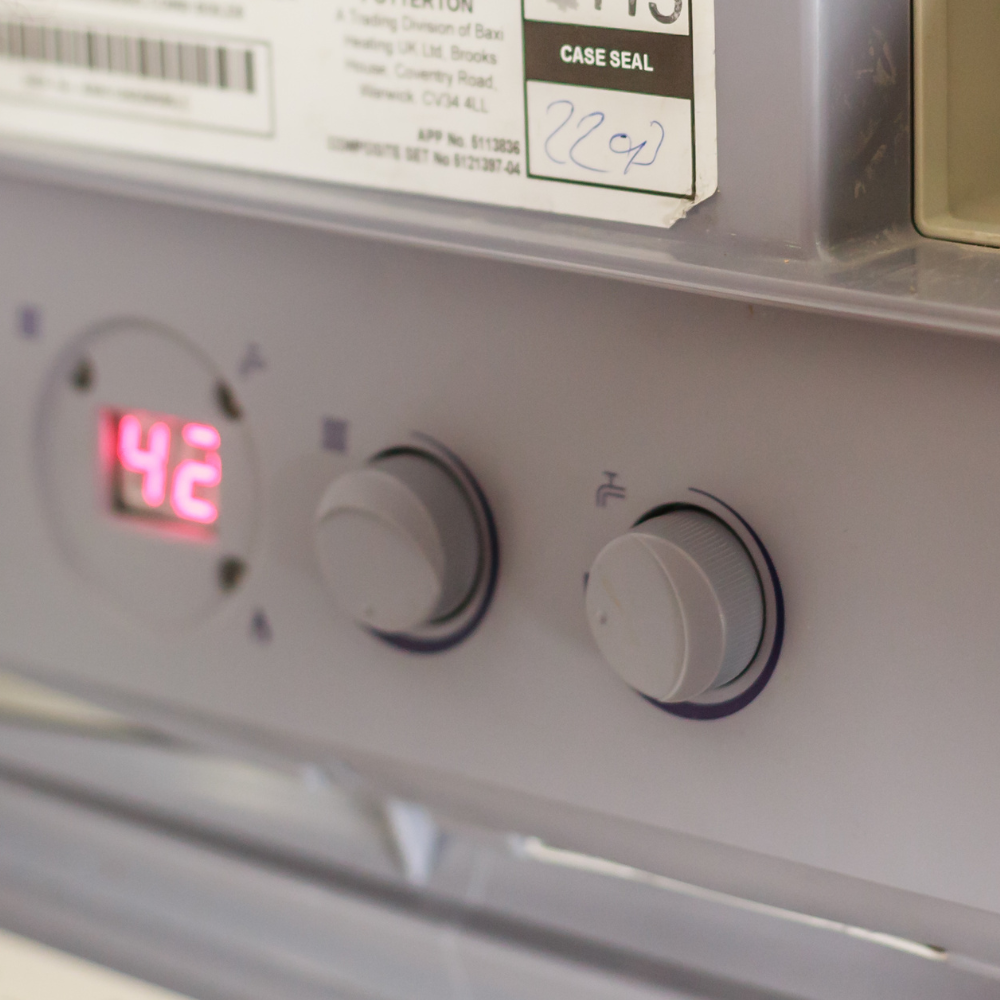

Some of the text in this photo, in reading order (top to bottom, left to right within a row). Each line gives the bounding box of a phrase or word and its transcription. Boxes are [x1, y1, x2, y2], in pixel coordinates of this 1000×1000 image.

[402, 15, 454, 36] Division
[458, 22, 471, 37] of
[475, 23, 504, 41] Baxi
[450, 45, 497, 65] Brooks
[560, 45, 653, 72] CASE SEAL
[117, 413, 222, 524] 42
